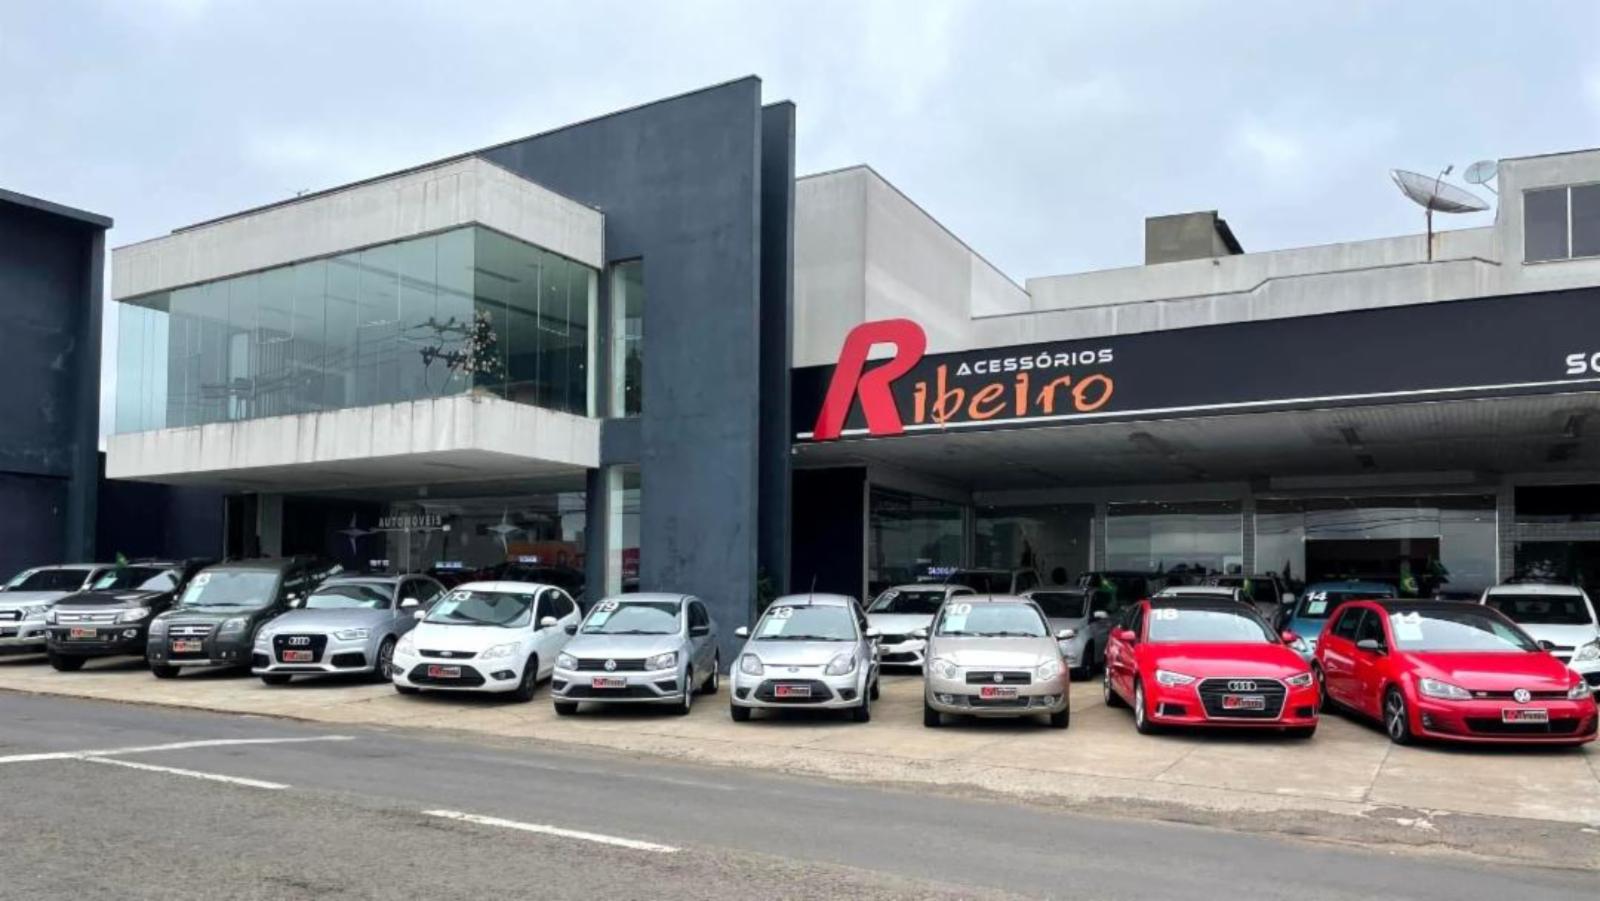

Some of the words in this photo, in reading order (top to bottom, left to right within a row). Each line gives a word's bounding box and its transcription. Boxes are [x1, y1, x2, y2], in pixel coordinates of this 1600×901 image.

[956, 348, 1114, 377] ACESSÓRIOS
[812, 318, 1114, 441] Ribeiro
[1306, 591, 1328, 601] 14
[951, 603, 972, 615] 10
[1153, 608, 1179, 621] 18
